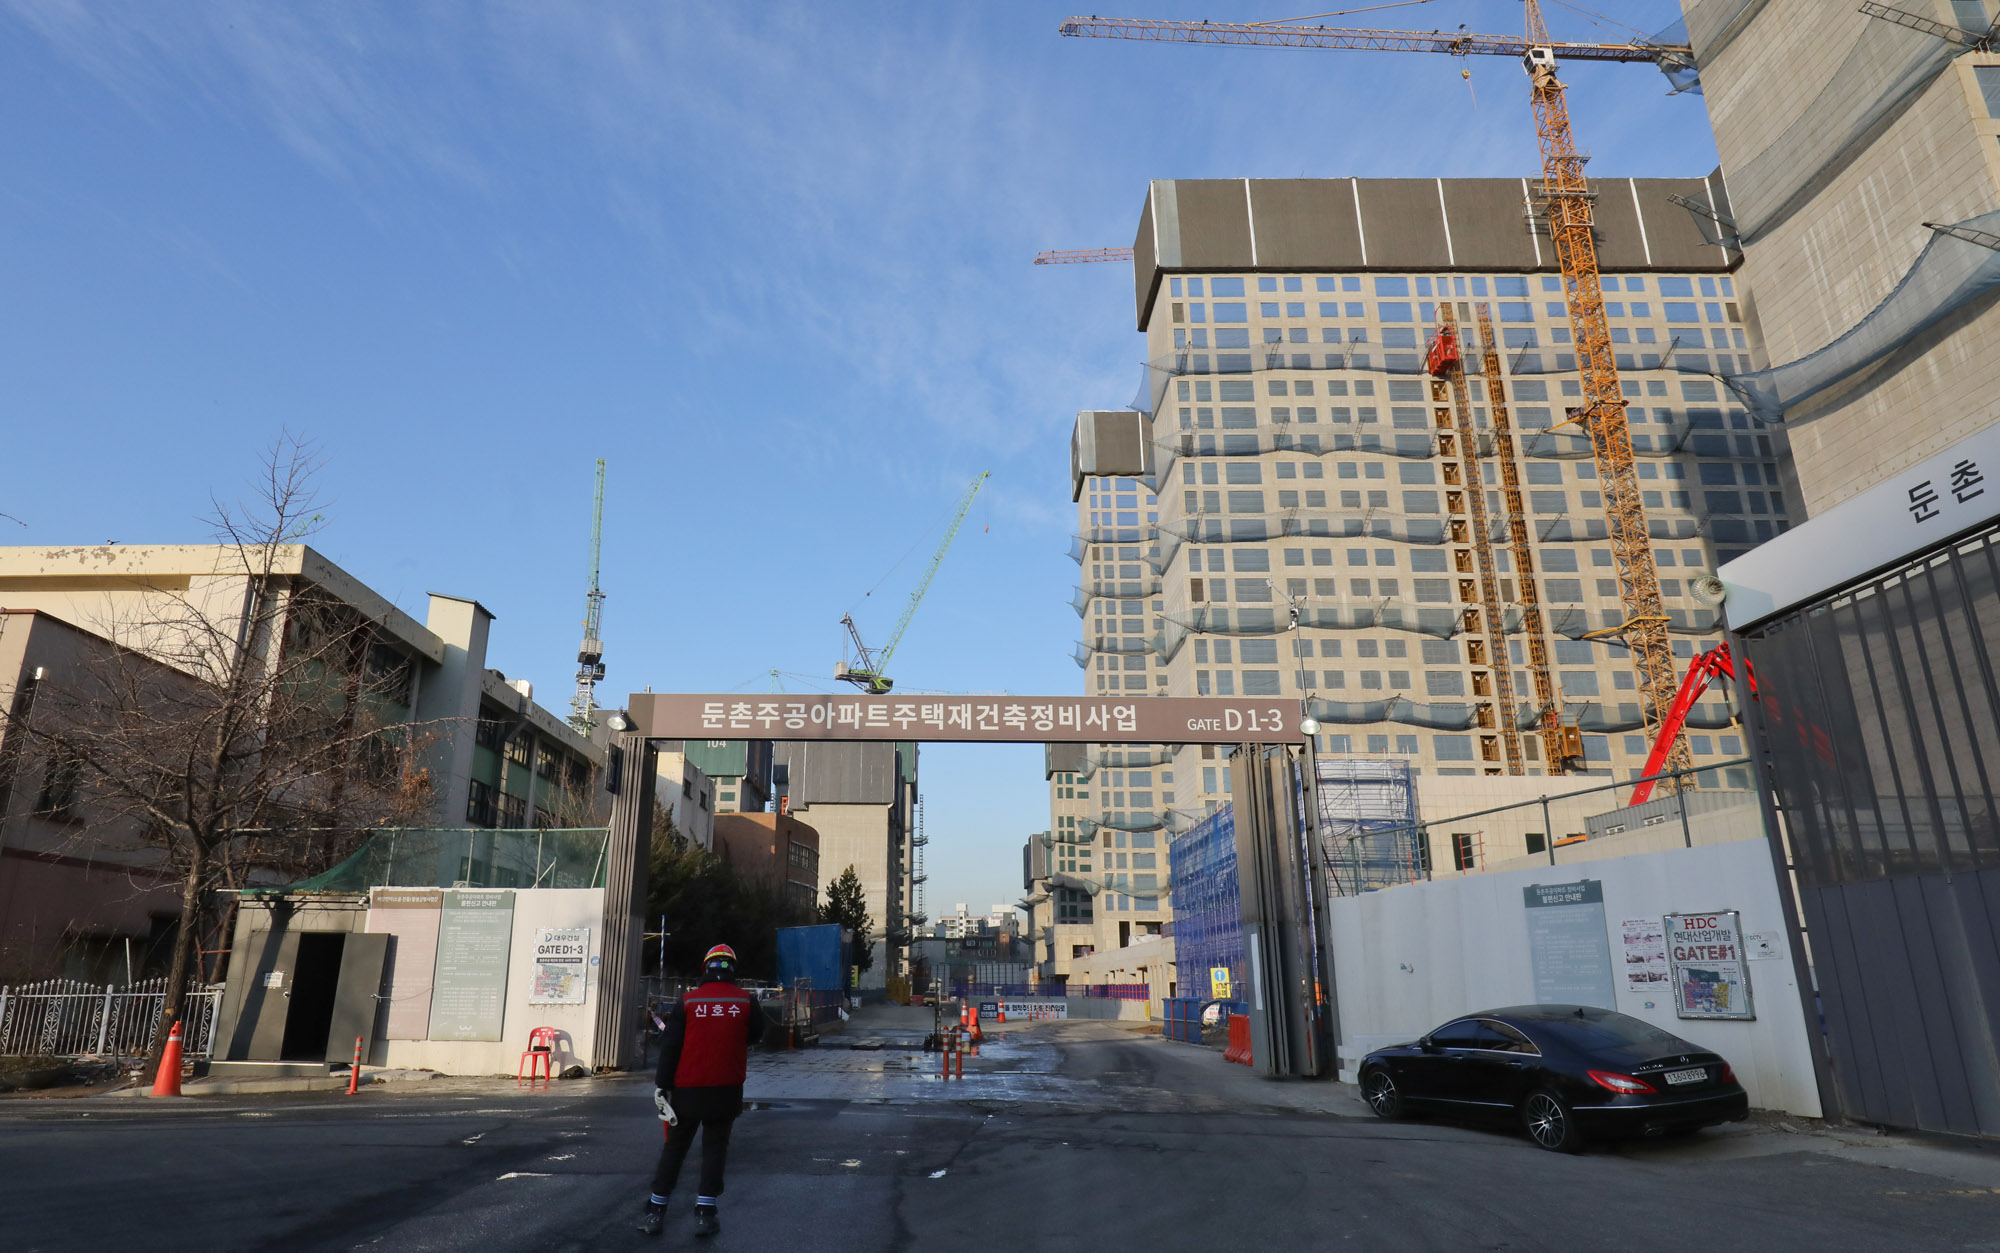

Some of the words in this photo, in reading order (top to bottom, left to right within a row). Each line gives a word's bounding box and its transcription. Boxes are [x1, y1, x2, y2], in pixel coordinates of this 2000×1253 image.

[701, 701, 1138, 731] 둔촌주공아파트주택재건축정비사업
[1187, 718, 1222, 731] GATE
[1683, 917, 1718, 930] HDC
[1673, 929, 1732, 943] 현대산업개발
[538, 945, 561, 955] GATE
[562, 945, 583, 955] D1-3
[1673, 944, 1736, 961] GATE#1
[694, 1004, 741, 1018] 신호수
